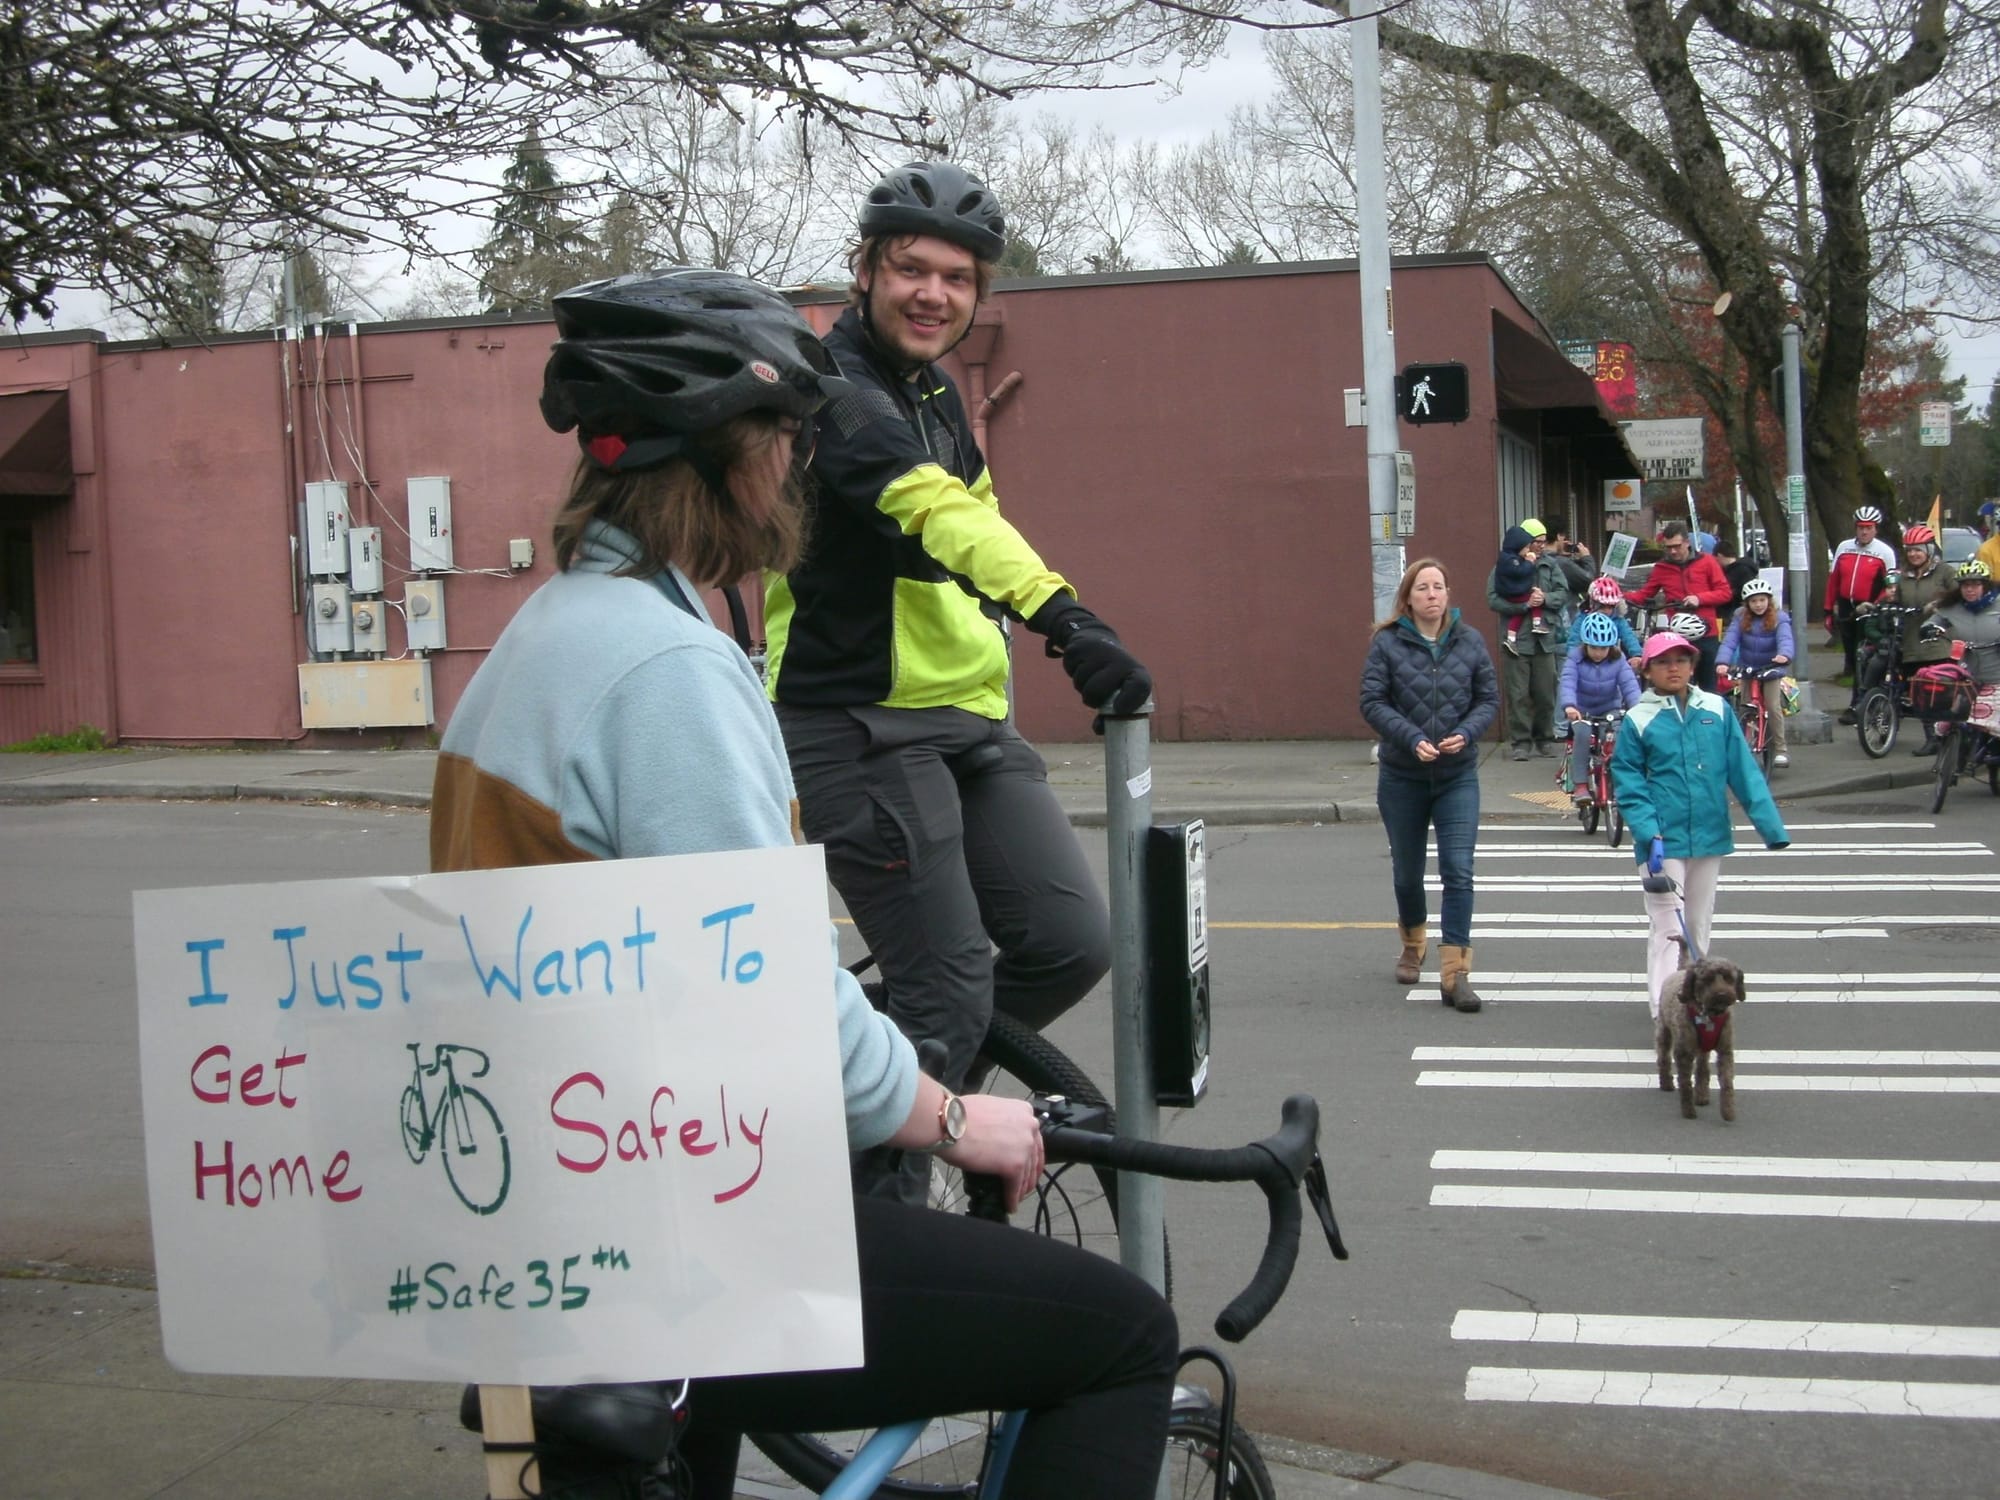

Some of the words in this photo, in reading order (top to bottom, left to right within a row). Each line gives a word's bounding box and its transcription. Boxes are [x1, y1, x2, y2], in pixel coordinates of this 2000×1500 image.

[755, 364, 775, 381] BELL
[1651, 459, 1666, 468] AND
[1672, 457, 1695, 468] CHIPS
[1667, 467, 1690, 478] TOWN
[186, 939, 229, 1008] I
[273, 926, 425, 1011] Just
[460, 904, 657, 1002] Want
[702, 903, 765, 985] To
[190, 1044, 307, 1108] Get
[549, 1071, 769, 1204] Safely
[193, 1139, 364, 1208] Home
